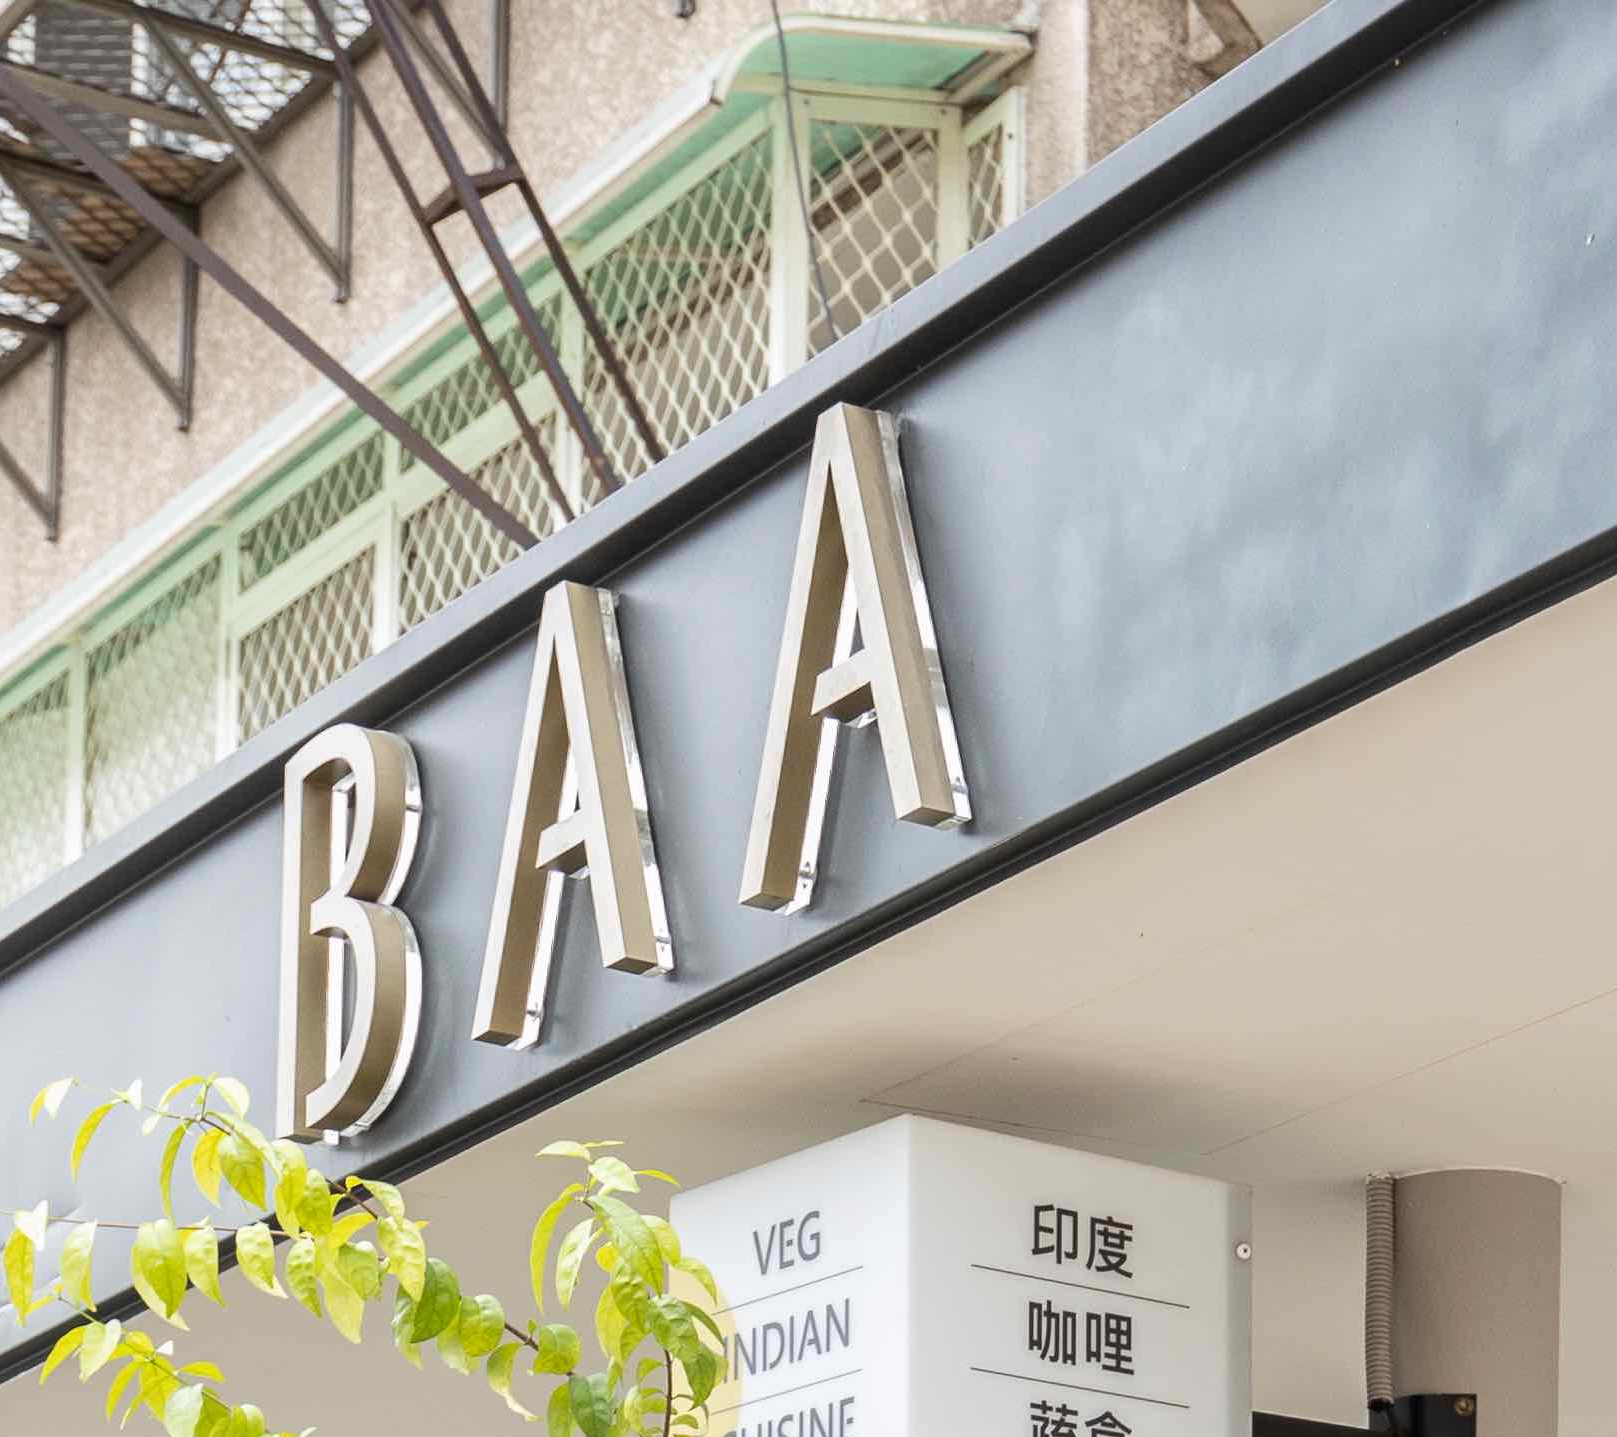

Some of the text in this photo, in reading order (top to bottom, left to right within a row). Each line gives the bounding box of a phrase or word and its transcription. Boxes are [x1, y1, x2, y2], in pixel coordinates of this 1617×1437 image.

[277, 401, 972, 1146] BAA
[752, 1210, 821, 1276] VEG
[1030, 1203, 1135, 1279] 印度
[722, 1298, 851, 1384] INDIAN
[1027, 1301, 1135, 1376] 咖哩
